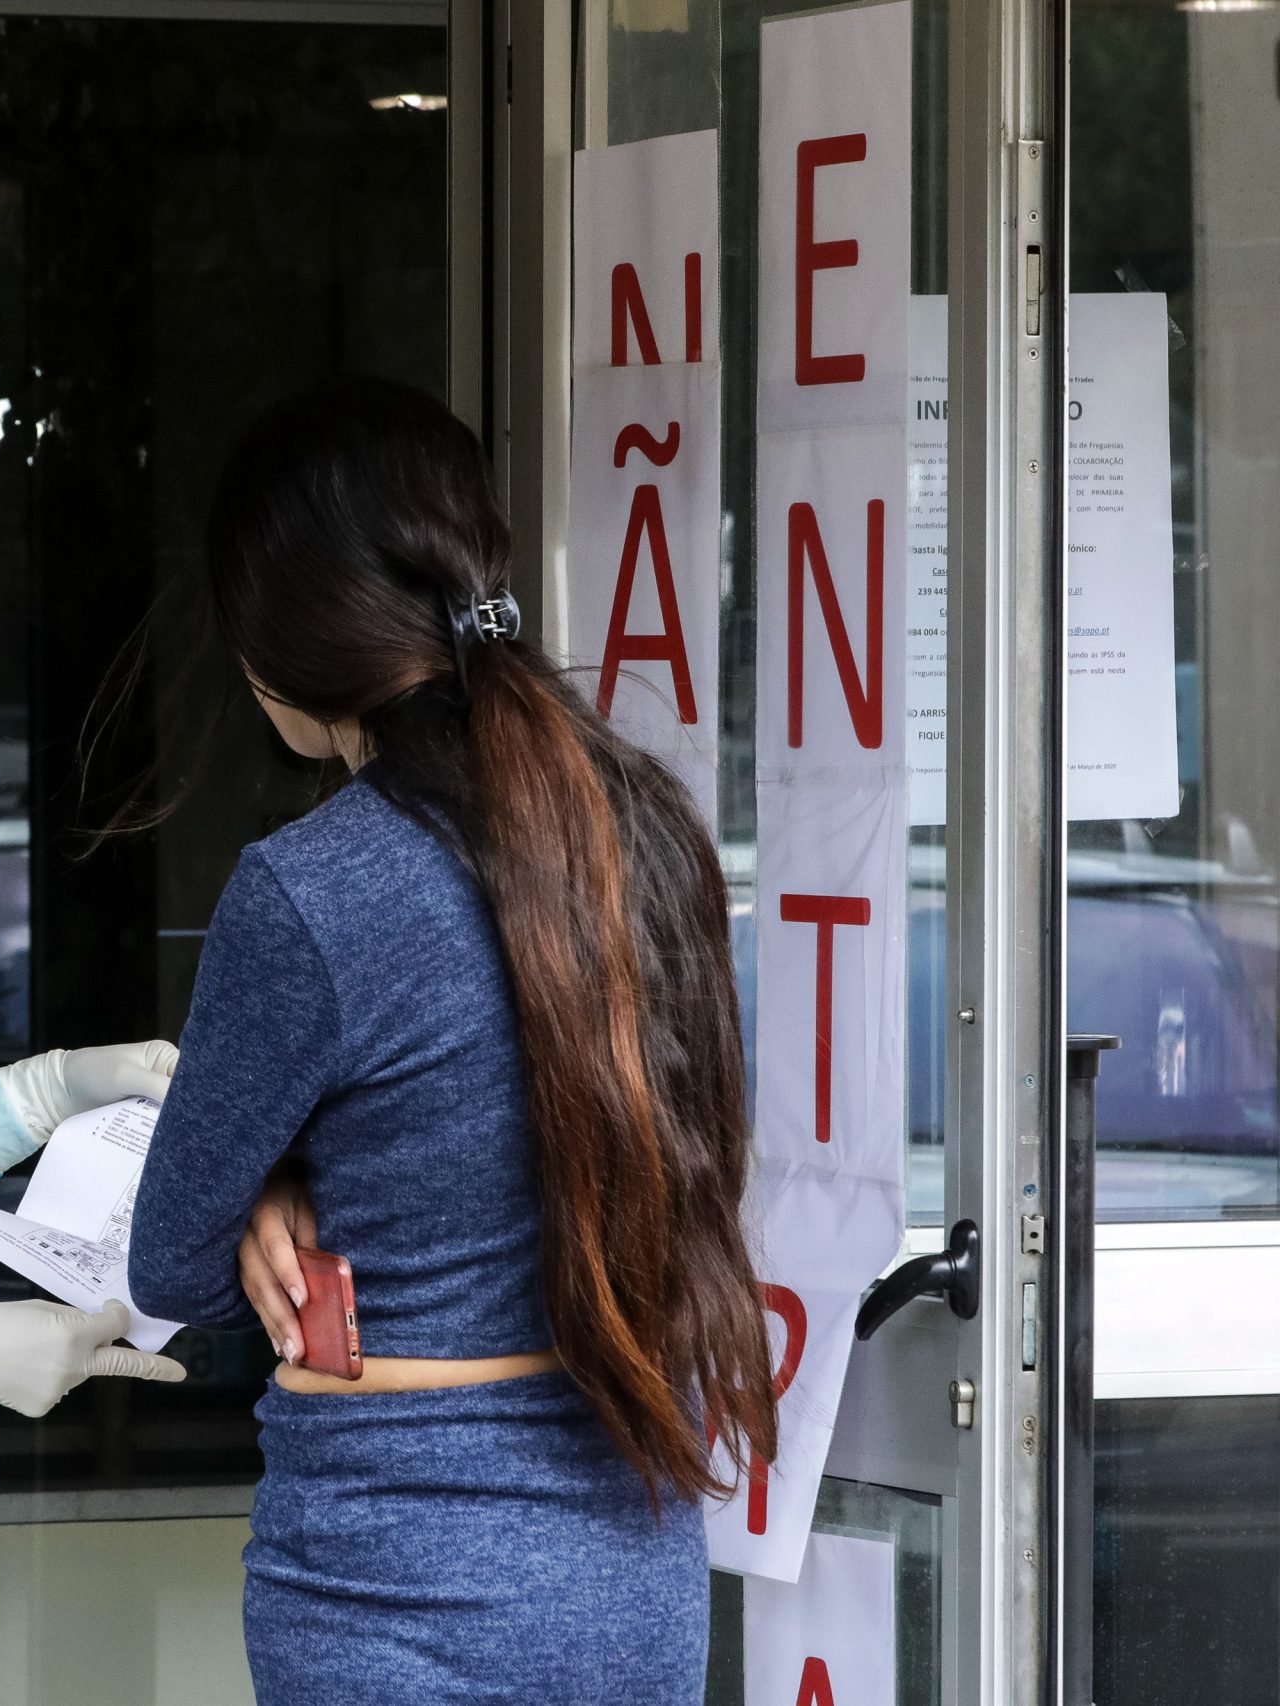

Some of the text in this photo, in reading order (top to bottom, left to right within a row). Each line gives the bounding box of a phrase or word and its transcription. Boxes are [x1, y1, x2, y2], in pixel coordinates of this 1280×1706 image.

[910, 441, 942, 449] andemia
[1080, 441, 1087, 449] de
[1090, 441, 1124, 451] Freguesias
[1074, 456, 1124, 467] COLABORAÇÃO
[1094, 473, 1105, 481] das
[919, 491, 934, 499] para
[1092, 489, 1124, 497] PRIMEIRA
[1097, 504, 1124, 514] doenças
[918, 587, 932, 595] 239
[924, 628, 938, 636] 004
[1068, 668, 1087, 676] quem
[1091, 666, 1105, 674] está
[918, 731, 945, 740] FIQUE
